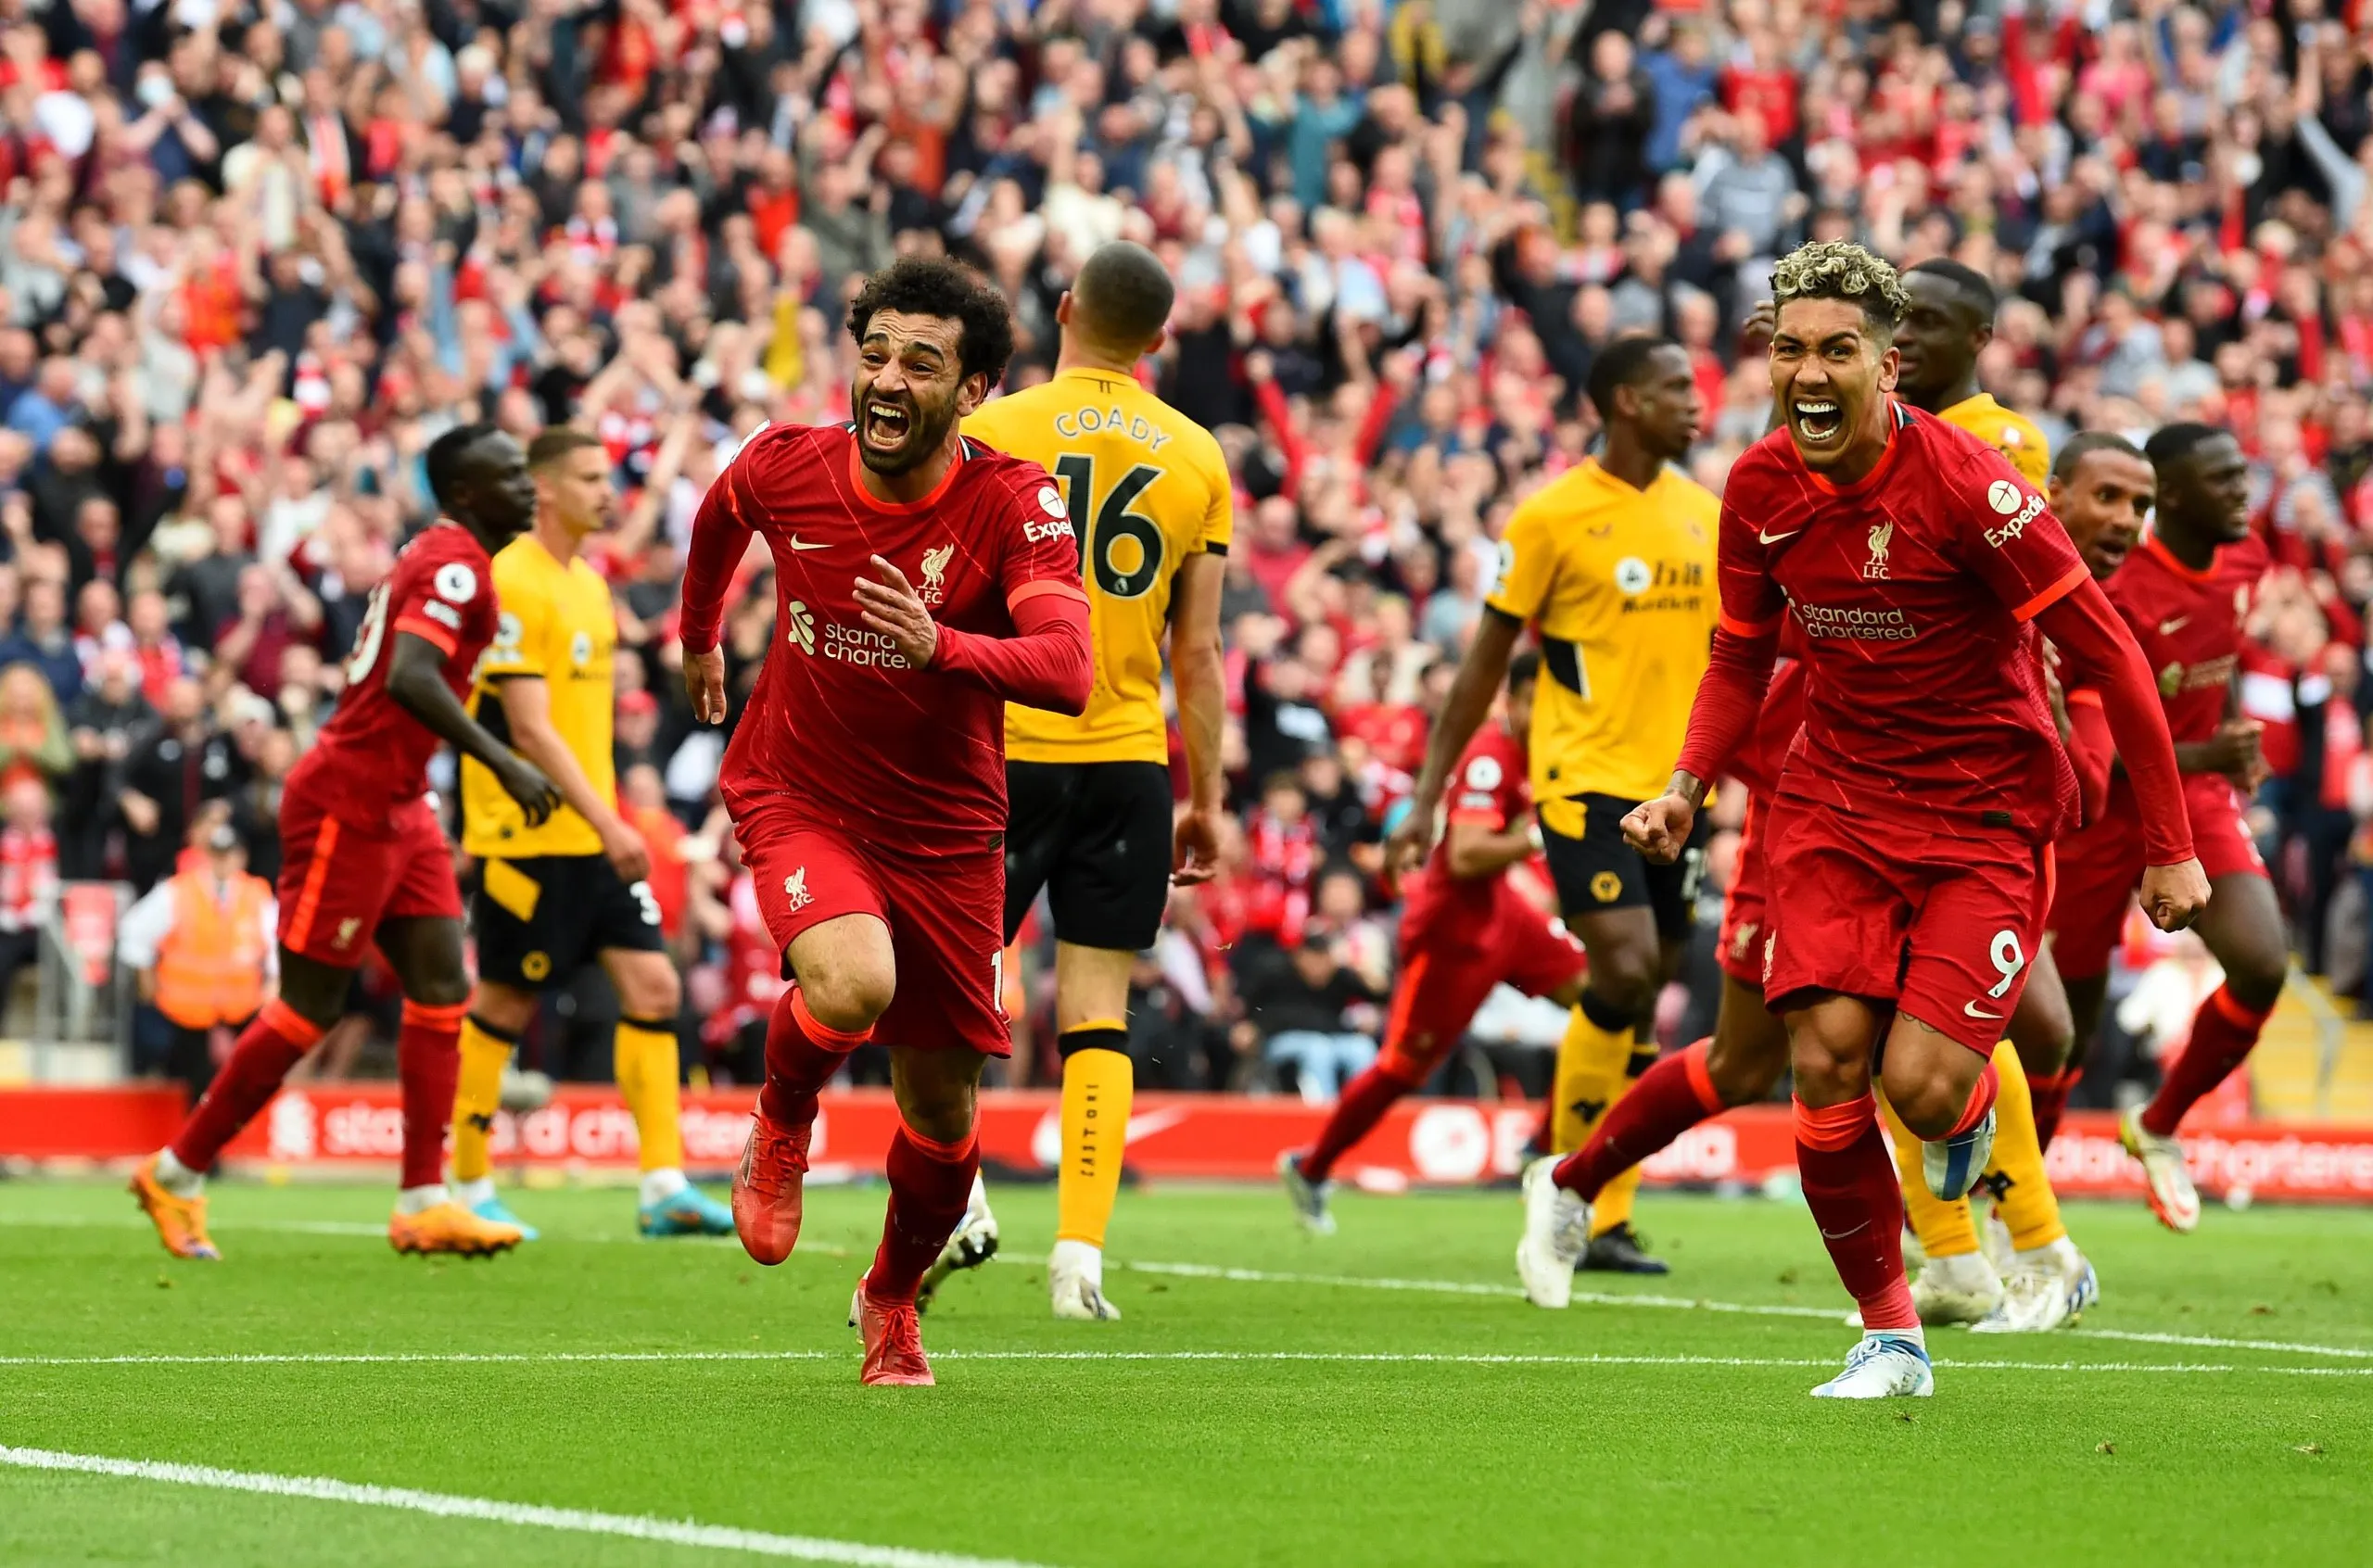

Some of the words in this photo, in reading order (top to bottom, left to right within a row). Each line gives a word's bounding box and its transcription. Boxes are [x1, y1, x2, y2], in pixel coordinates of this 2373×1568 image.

[1055, 406, 1172, 452] COADY
[1022, 520, 1076, 543] Expe
[1054, 452, 1166, 600] 16
[1802, 603, 1904, 625] standard
[1808, 622, 1917, 640] chartered
[1987, 929, 2024, 999] 9
